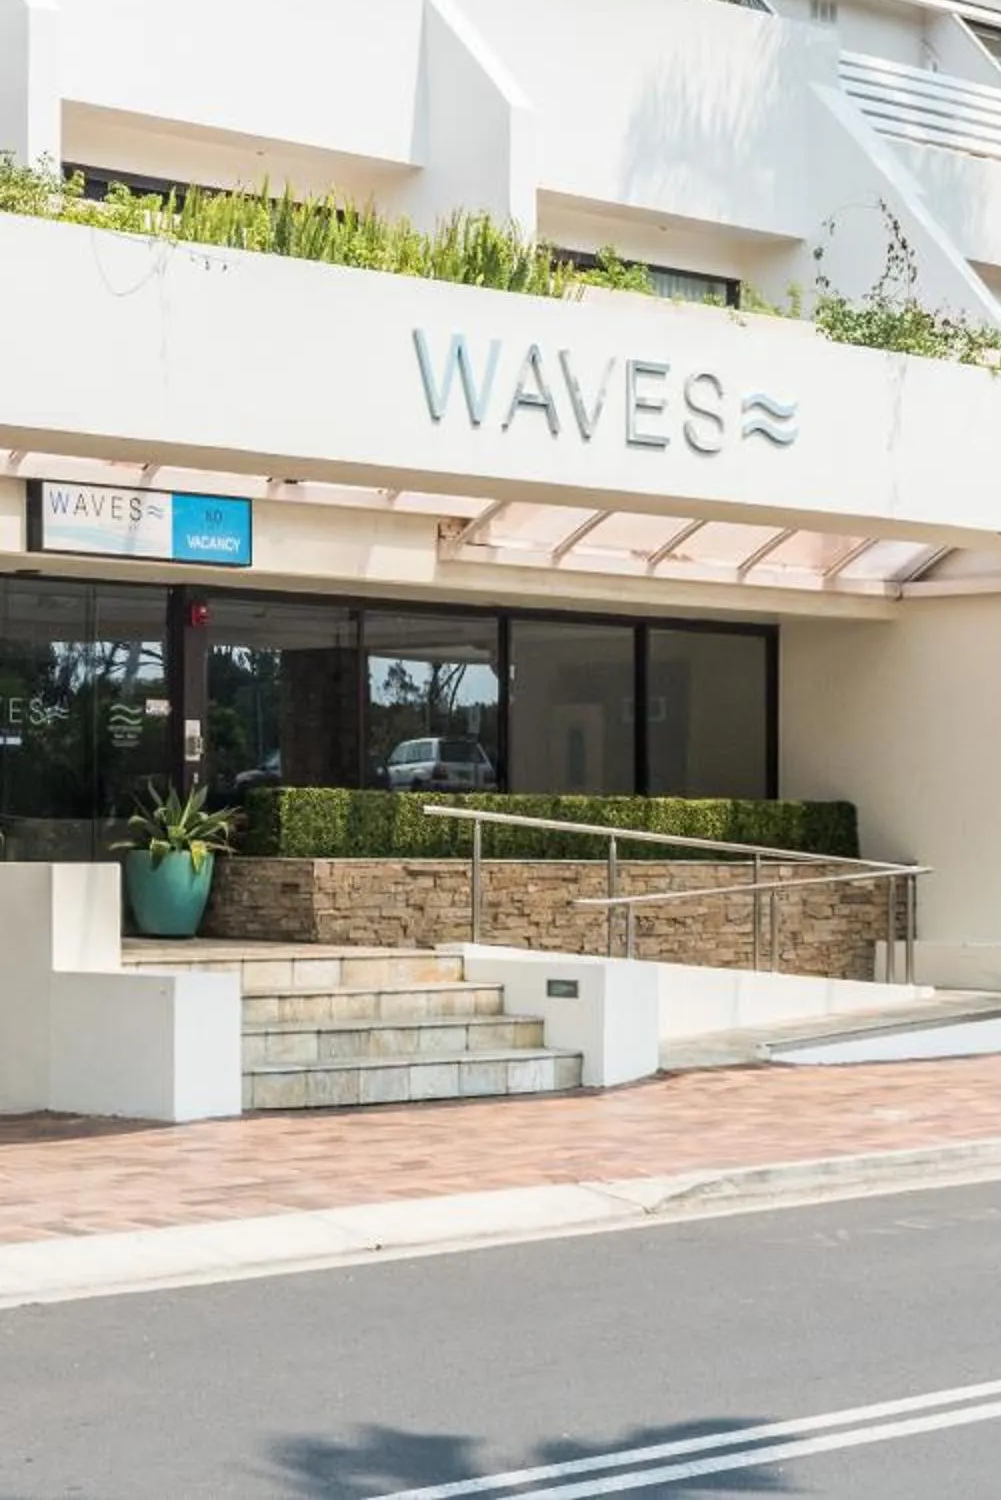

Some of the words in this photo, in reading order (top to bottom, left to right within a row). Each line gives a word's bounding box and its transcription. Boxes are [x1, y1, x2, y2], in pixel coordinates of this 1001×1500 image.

[412, 328, 725, 456] WAVES
[50, 490, 143, 522] WAVES
[185, 533, 241, 553] VACANCY
[0, 696, 44, 726] ES
